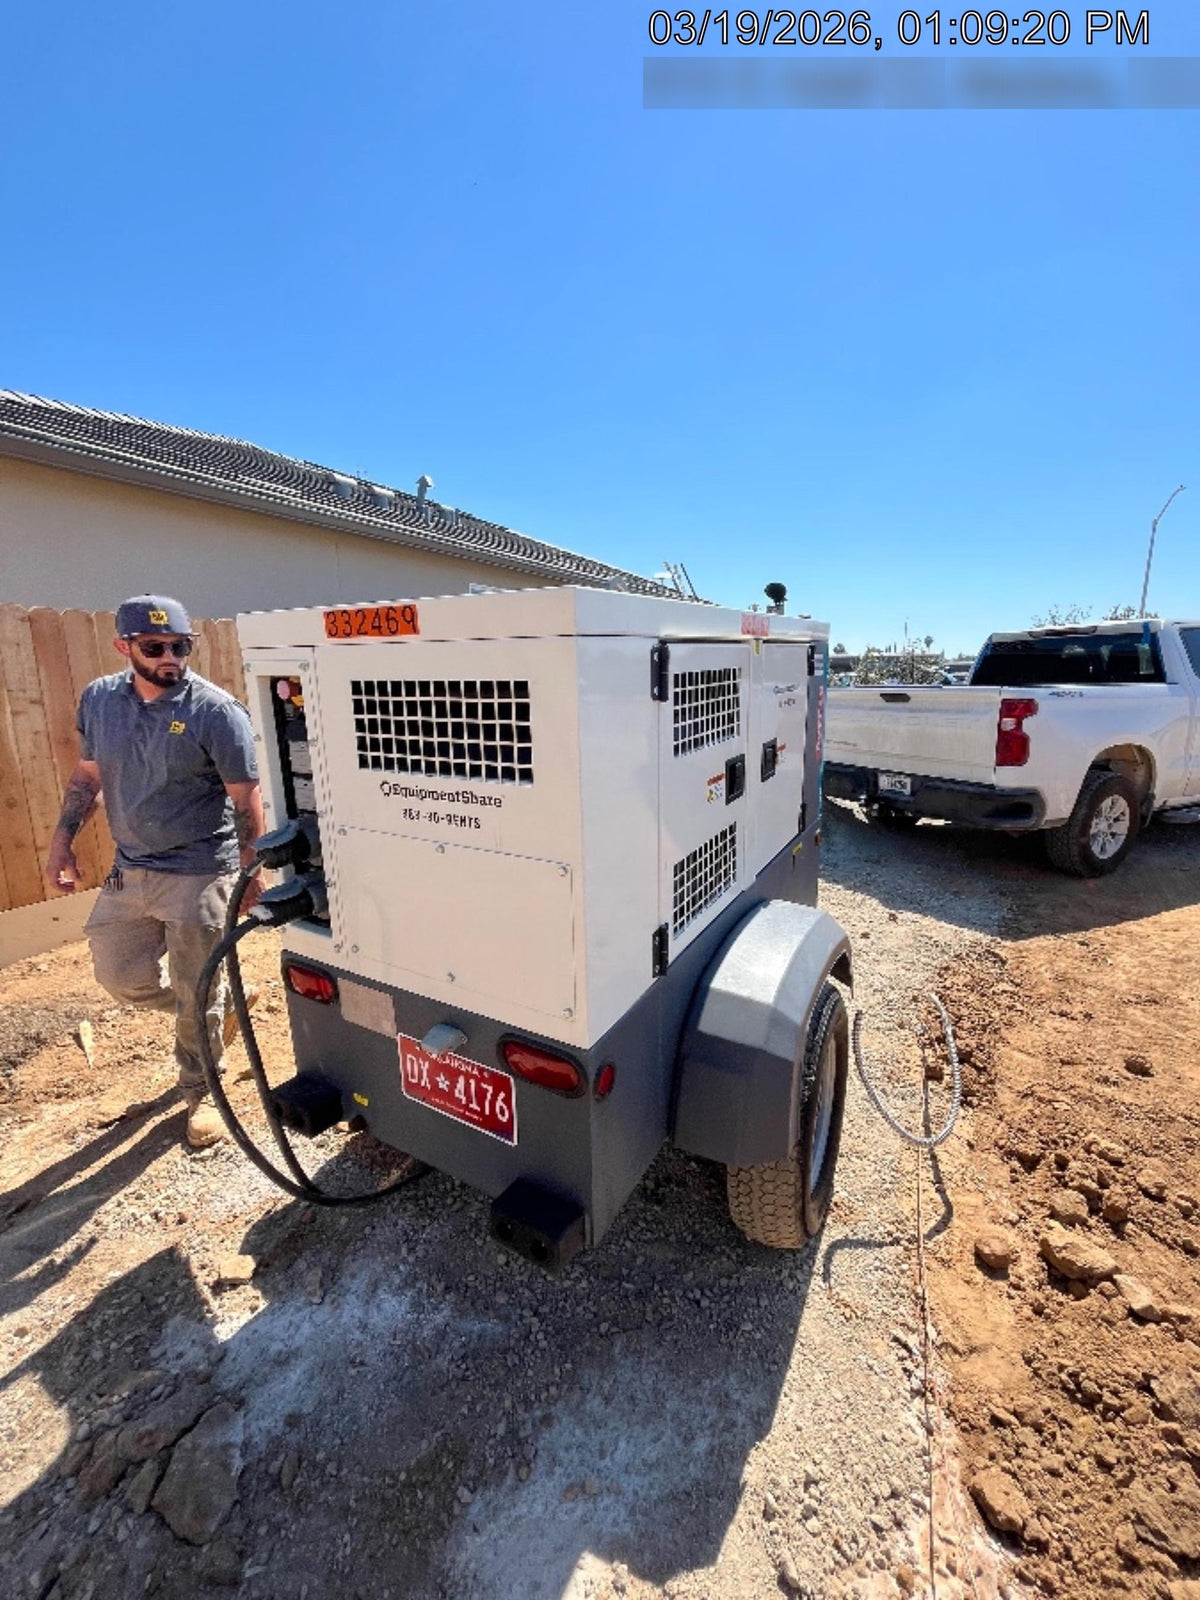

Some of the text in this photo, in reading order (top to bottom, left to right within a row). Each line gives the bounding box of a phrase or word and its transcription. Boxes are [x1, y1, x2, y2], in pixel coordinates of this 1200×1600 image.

[326, 605, 417, 637] 332469
[392, 783, 502, 808] EquipmentShare
[454, 1074, 509, 1123] 4176
